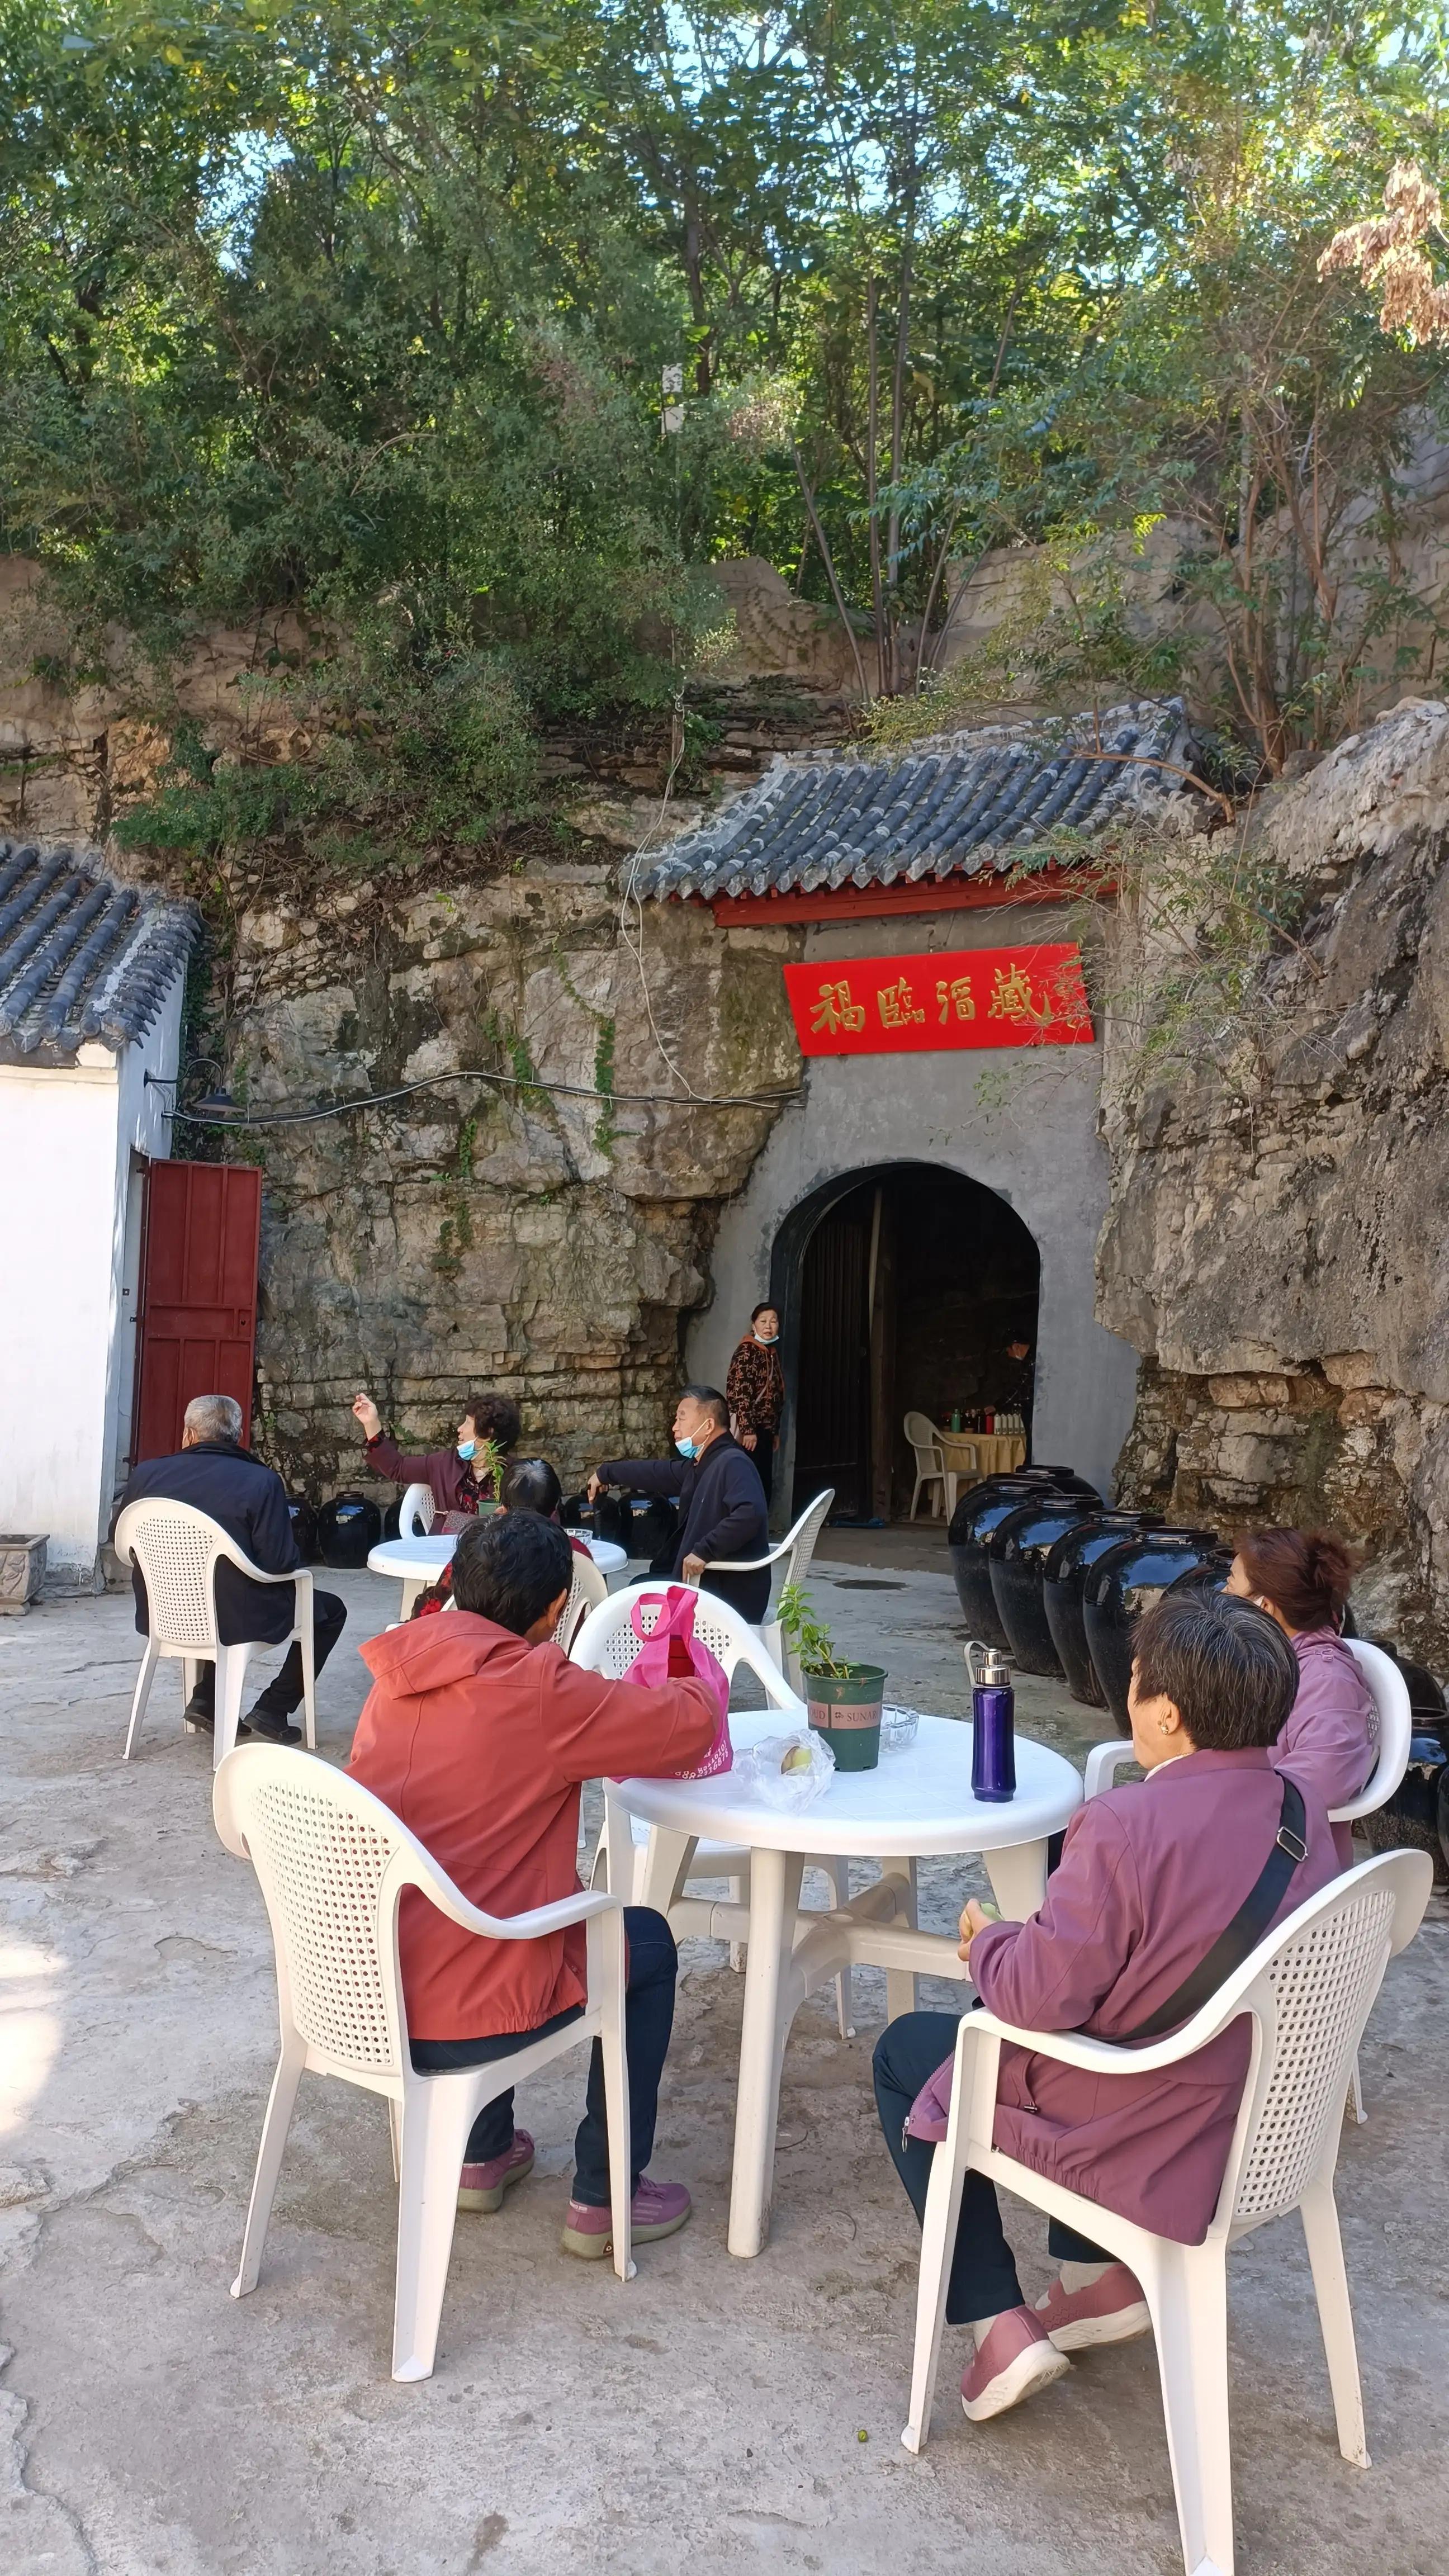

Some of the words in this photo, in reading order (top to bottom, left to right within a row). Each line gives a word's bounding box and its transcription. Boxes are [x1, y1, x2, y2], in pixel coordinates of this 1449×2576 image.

[810, 963, 1082, 1034] 福臨酒藏
[846, 1710, 878, 1722] SUNAR
